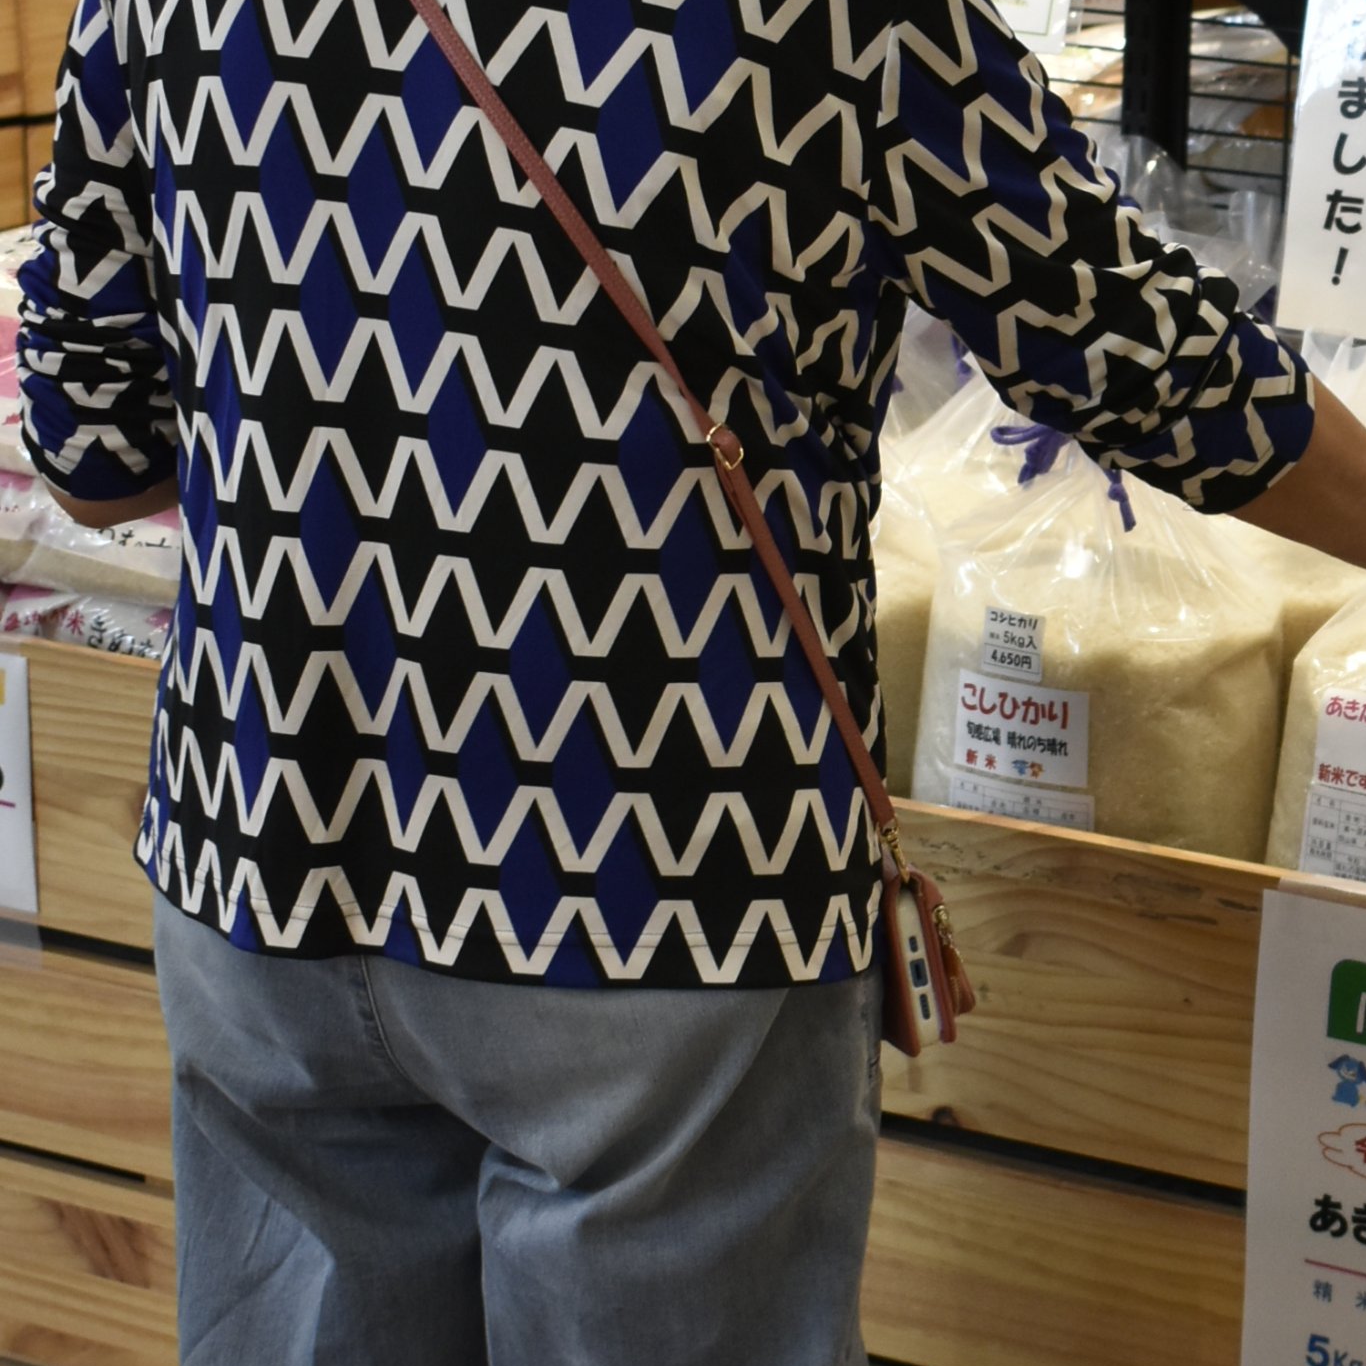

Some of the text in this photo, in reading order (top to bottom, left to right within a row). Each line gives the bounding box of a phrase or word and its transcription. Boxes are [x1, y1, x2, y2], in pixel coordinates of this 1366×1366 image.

[990, 610, 1039, 631] コシヒカリ
[1003, 630, 1038, 650] 5kg入
[960, 682, 1070, 730] こしひかり
[1006, 733, 1069, 757] 晴れのち晴れ
